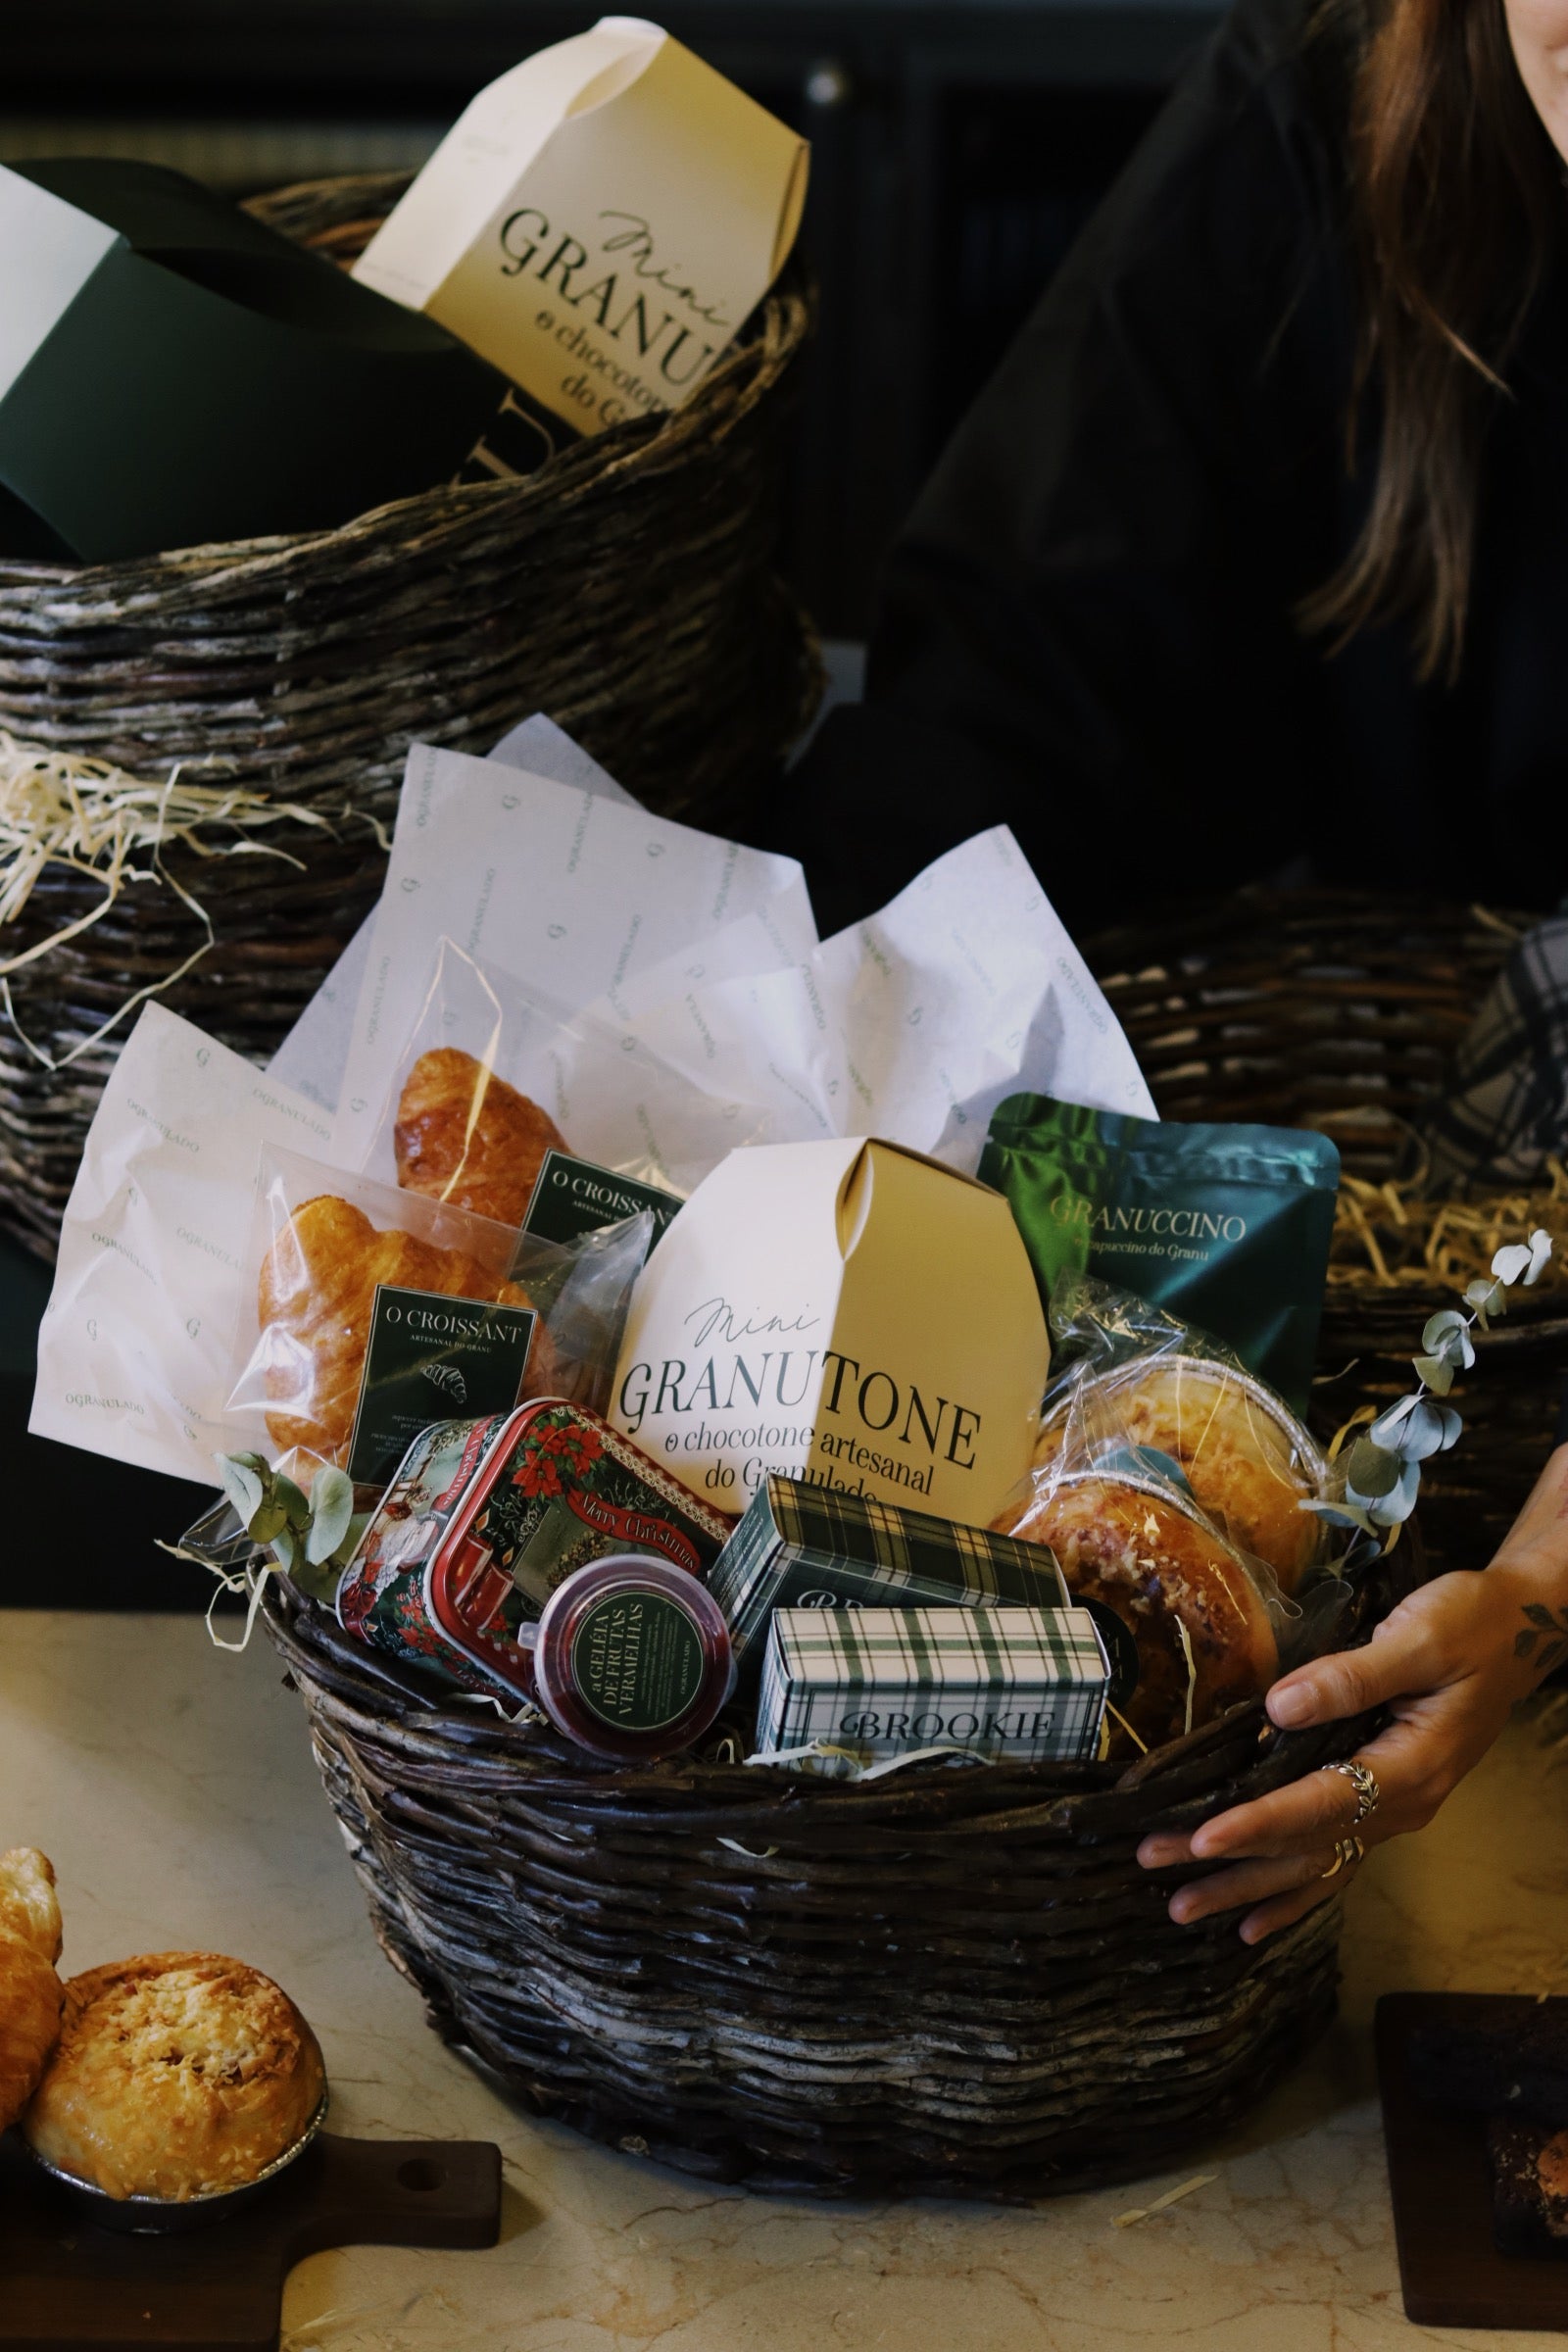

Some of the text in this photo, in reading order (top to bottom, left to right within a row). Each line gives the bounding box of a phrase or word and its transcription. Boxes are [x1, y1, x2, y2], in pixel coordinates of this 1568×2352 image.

[498, 208, 714, 388] GRANU
[597, 209, 730, 327] Mini
[554, 325, 667, 414] chocoton
[553, 1170, 569, 1188] O
[1050, 1195, 1247, 1243] GRANUCCINO
[1149, 1241, 1165, 1255] do
[1166, 1244, 1208, 1261] Granu
[386, 1305, 522, 1345] O CROISSANT
[410, 1335, 453, 1348] ARTESANAL
[683, 1297, 821, 1349] Mini
[618, 1349, 981, 1471] GRANUTONE
[664, 1421, 935, 1496] o chocotone artesanal
[705, 1458, 736, 1490] do
[581, 1493, 617, 1534] Merry
[624, 1517, 697, 1570] Christmas
[589, 1614, 611, 1693] a GELÉIA
[603, 1607, 626, 1705] DE FRUTAS
[619, 1602, 644, 1715] VERMELHAS
[839, 1710, 1056, 1741] BROOKIE
